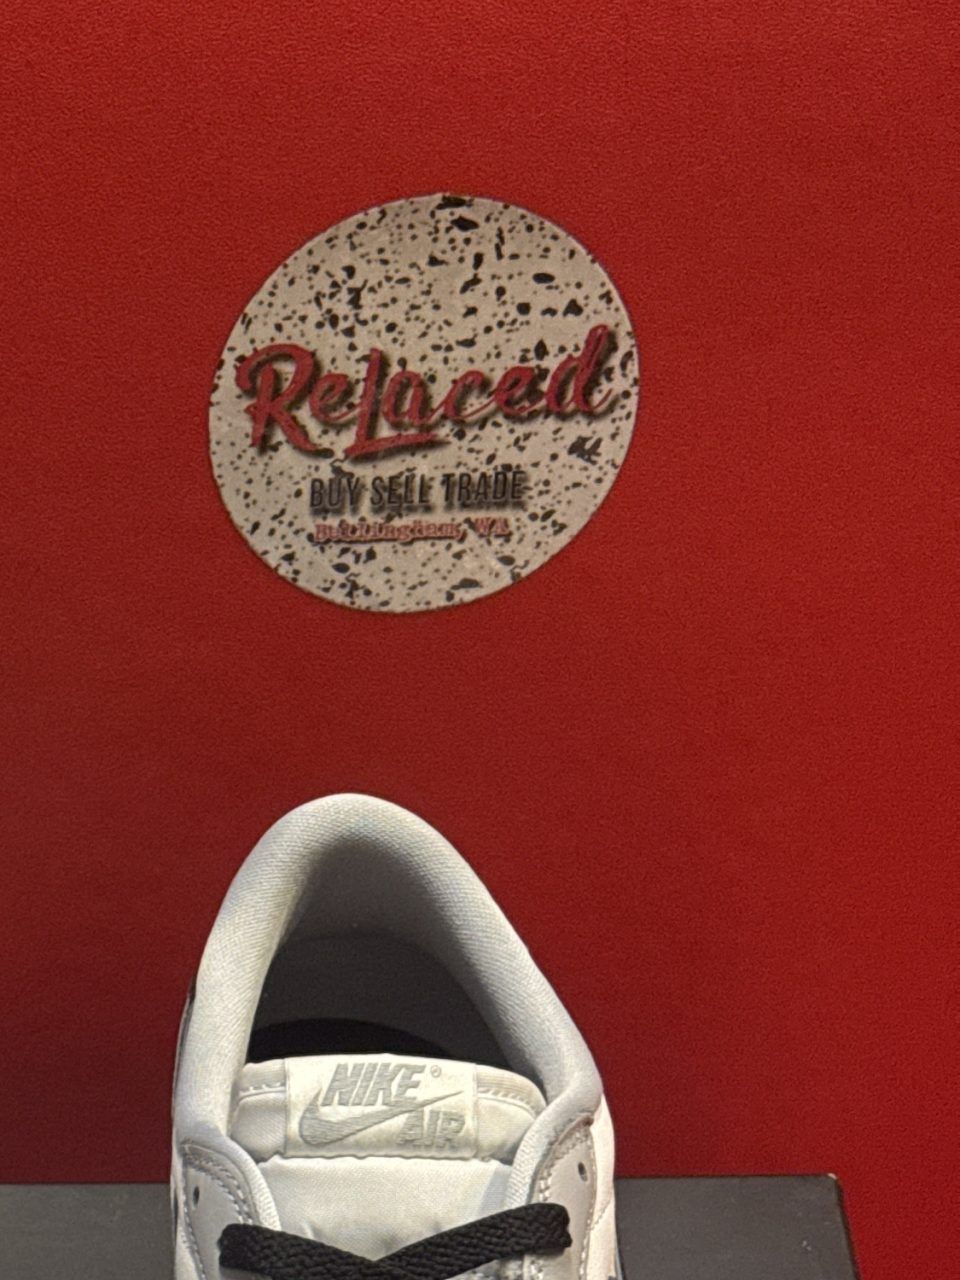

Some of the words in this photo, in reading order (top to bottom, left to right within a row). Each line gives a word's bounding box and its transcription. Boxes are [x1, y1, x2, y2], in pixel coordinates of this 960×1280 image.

[310, 476, 361, 509] BUY
[370, 472, 432, 506] SELL
[441, 469, 527, 503] TRADE
[320, 1062, 426, 1107] NIKE
[396, 1109, 466, 1149] AIR
